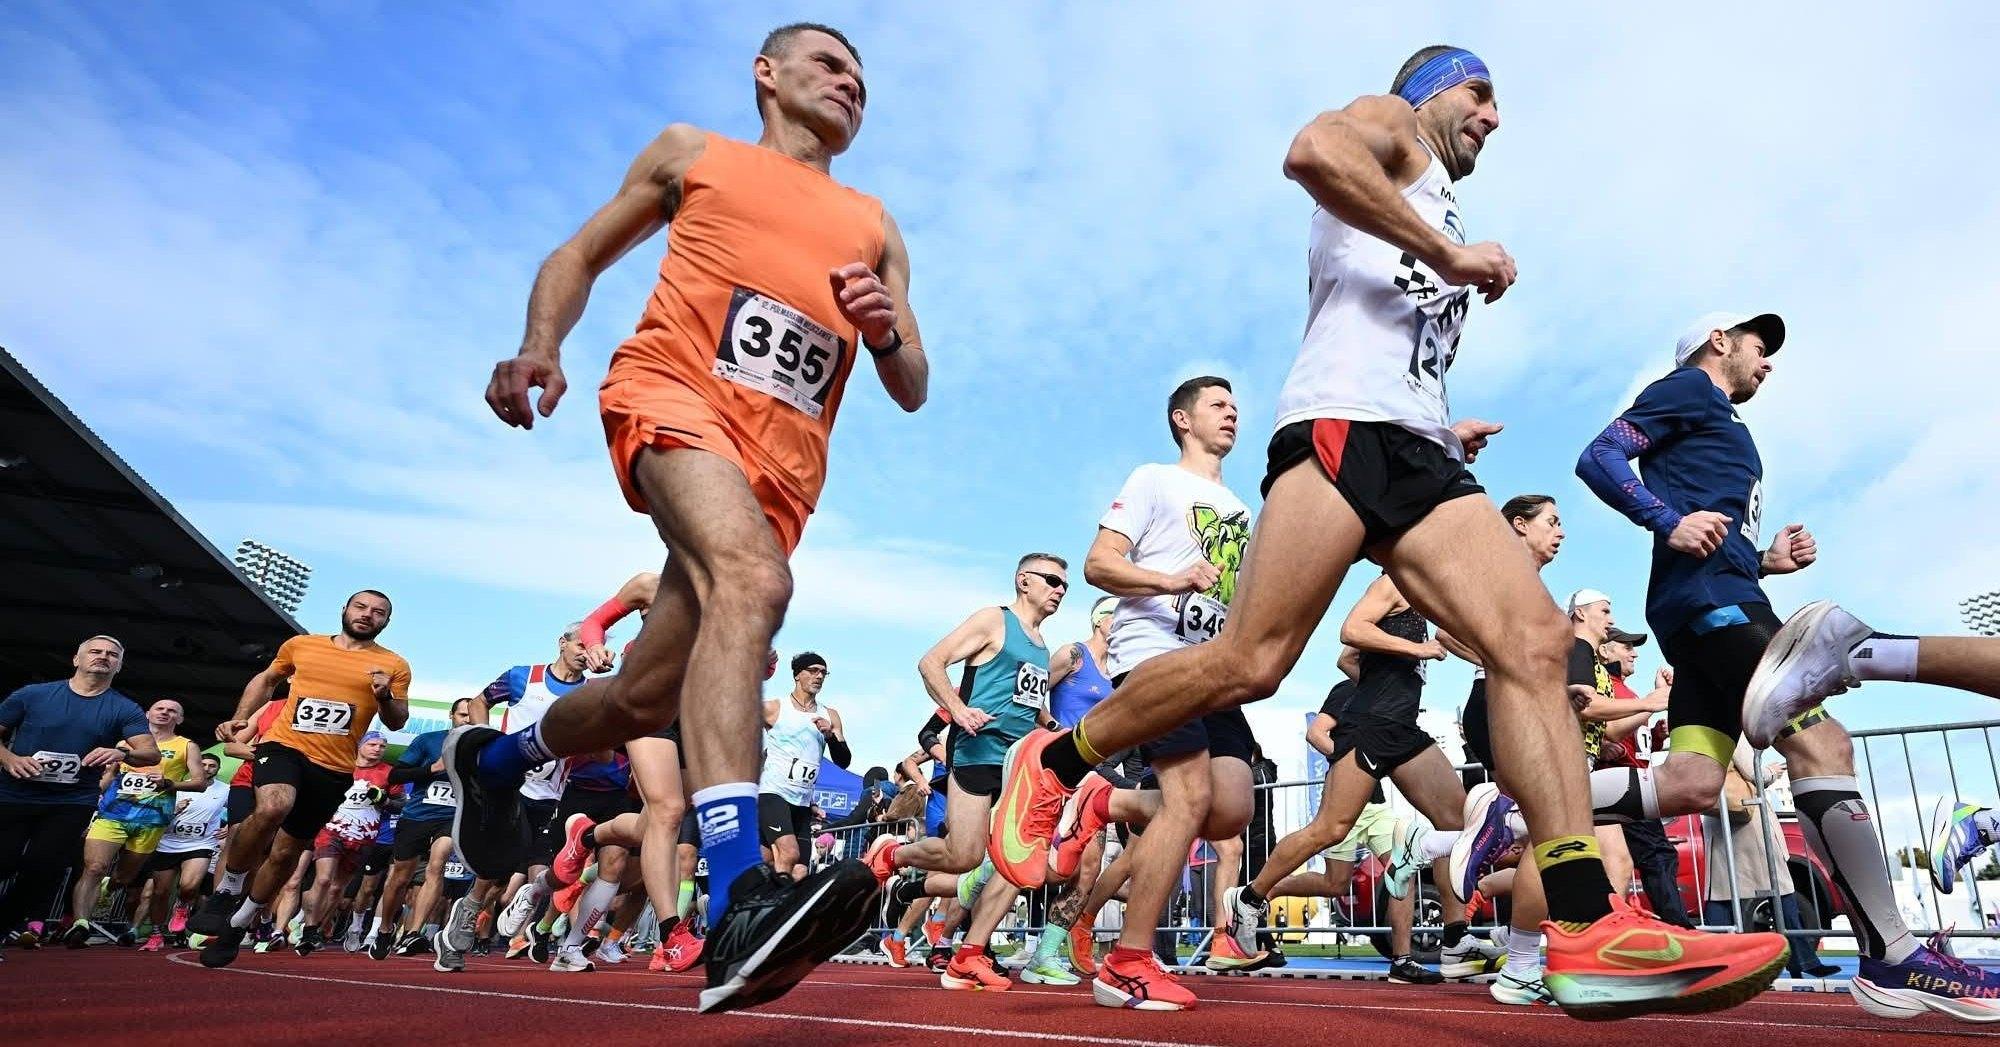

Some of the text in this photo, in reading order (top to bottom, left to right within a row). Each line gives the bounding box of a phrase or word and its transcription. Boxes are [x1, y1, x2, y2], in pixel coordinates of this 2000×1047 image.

[739, 315, 831, 385] 355
[1020, 673, 1048, 697] 620
[299, 705, 348, 724] 327
[802, 766, 816, 780] 16
[123, 777, 156, 789] 682
[176, 824, 202, 834] 635
[1907, 970, 1999, 1000] KIPRUN
